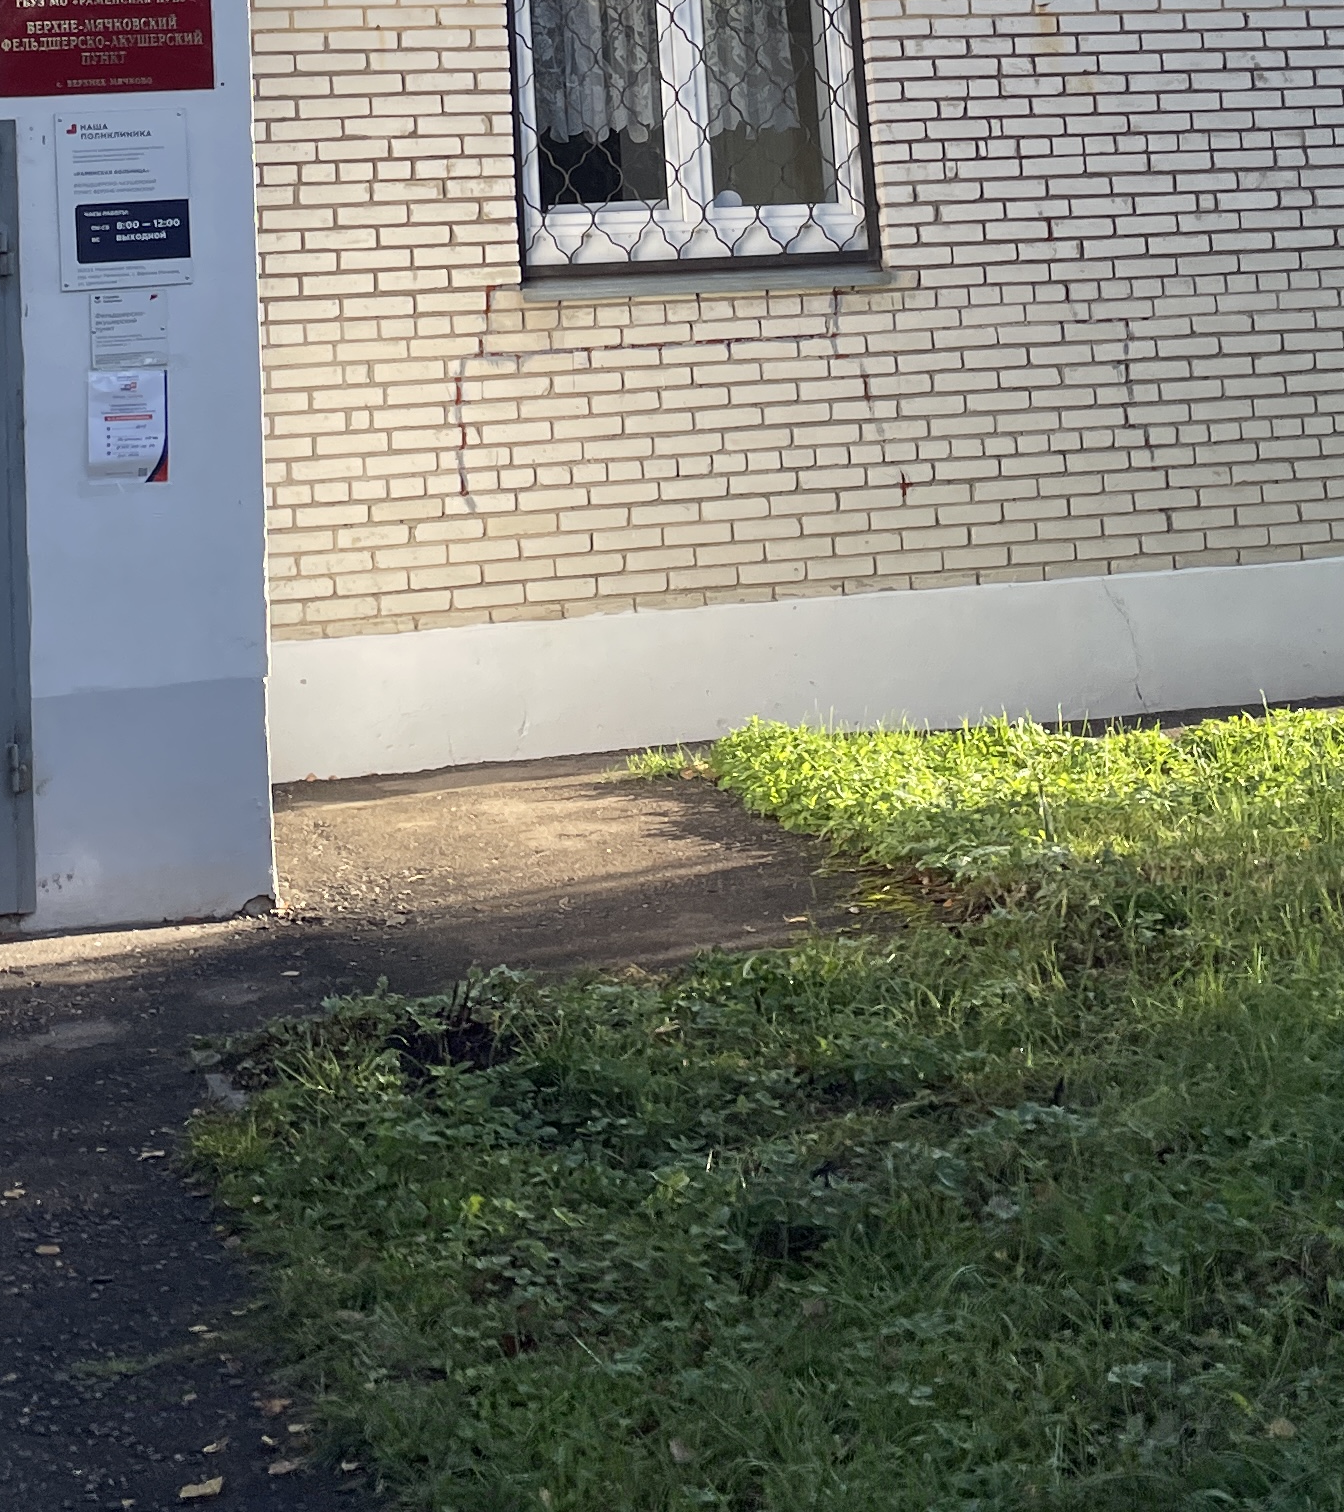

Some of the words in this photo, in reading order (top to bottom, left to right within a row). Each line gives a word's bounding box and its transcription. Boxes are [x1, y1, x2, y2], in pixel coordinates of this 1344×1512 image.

[26, 13, 178, 35] ВЕРХНЕ-МЯЧКОВСКИЙ
[0, 29, 205, 52] ФЕЛЬДШЕРСКО-АКУШЕРСКИЙ
[80, 51, 128, 66] ПУНКТ
[79, 123, 109, 131] НАША
[80, 130, 152, 140] ПОЛИКЛИНИКА
[153, 218, 181, 228] 12:00
[116, 230, 167, 242] ВЫХОДНОЙ
